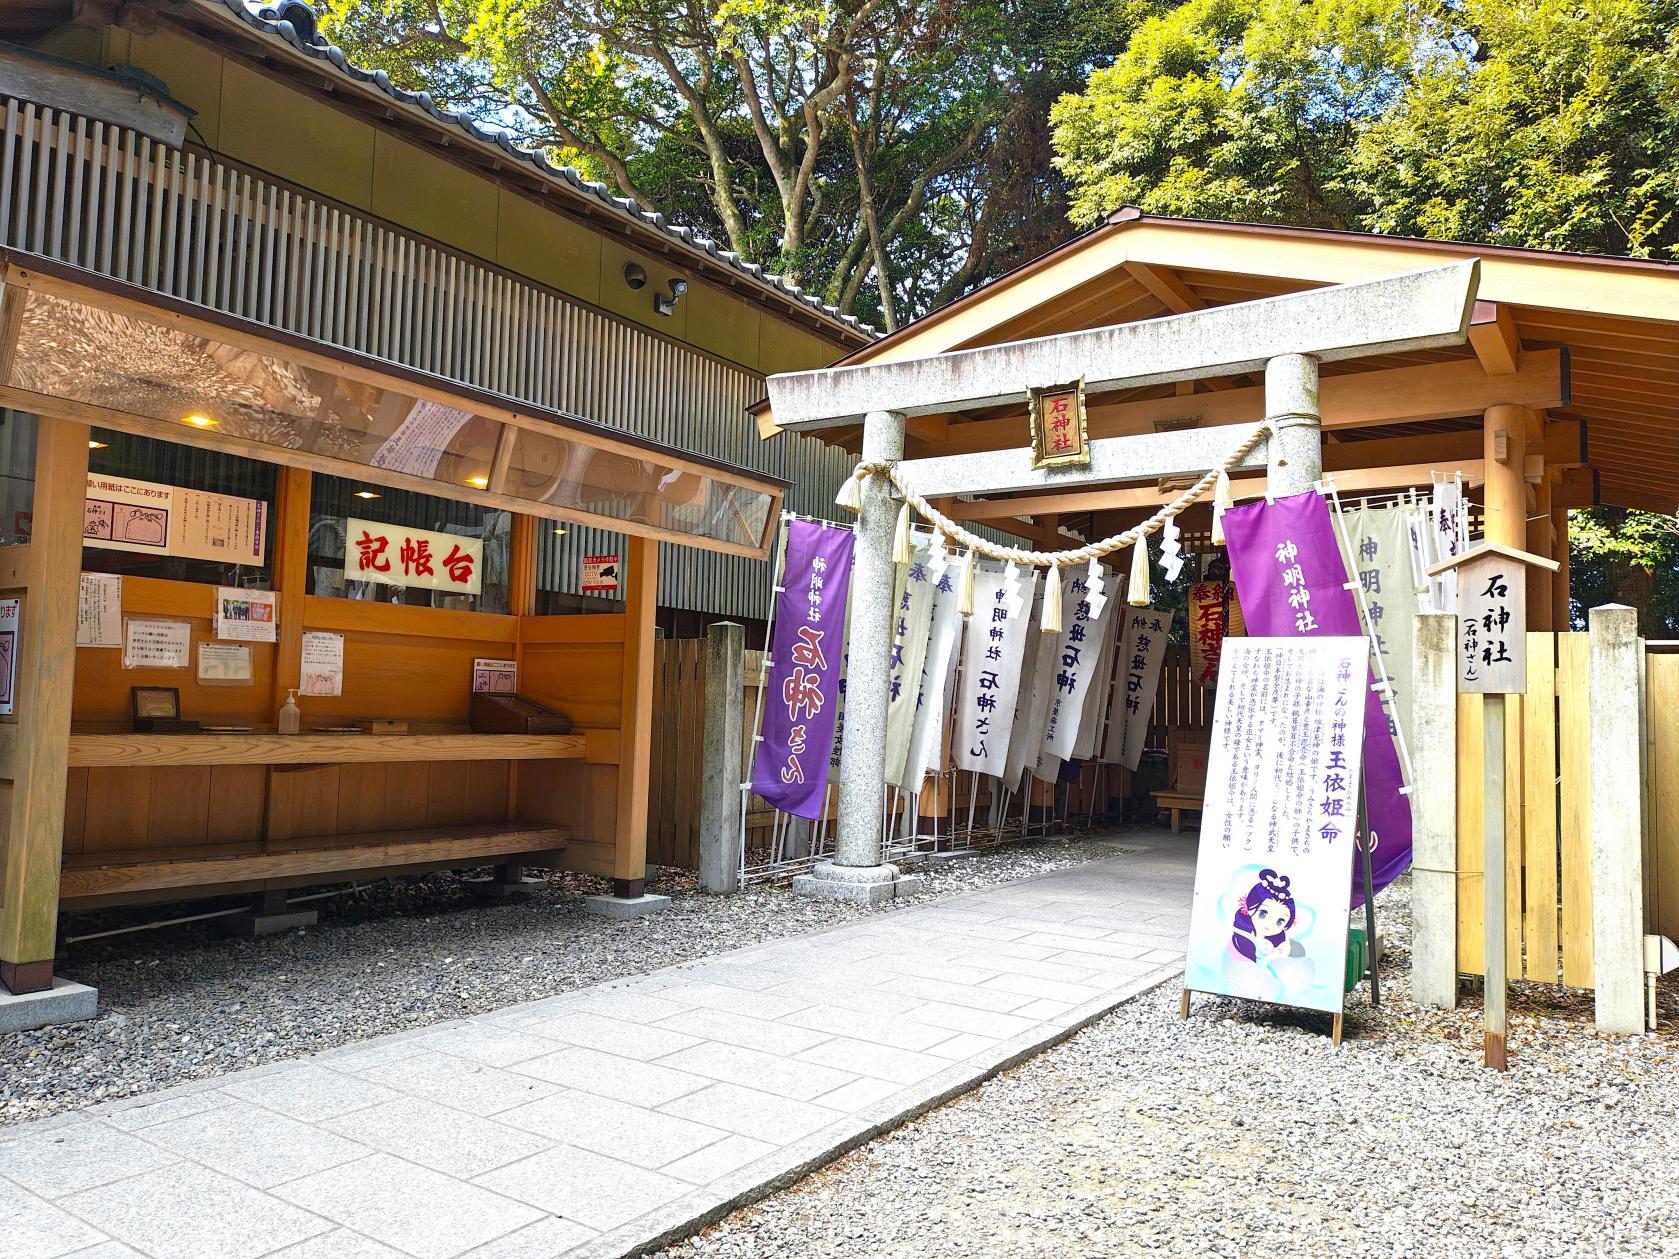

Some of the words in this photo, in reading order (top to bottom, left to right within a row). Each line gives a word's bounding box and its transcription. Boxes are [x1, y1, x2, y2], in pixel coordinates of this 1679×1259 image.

[1049, 396, 1073, 451] 石神社
[355, 529, 475, 584] 記帳台
[1275, 539, 1319, 633] 神明神社
[1480, 574, 1513, 667] 石神社
